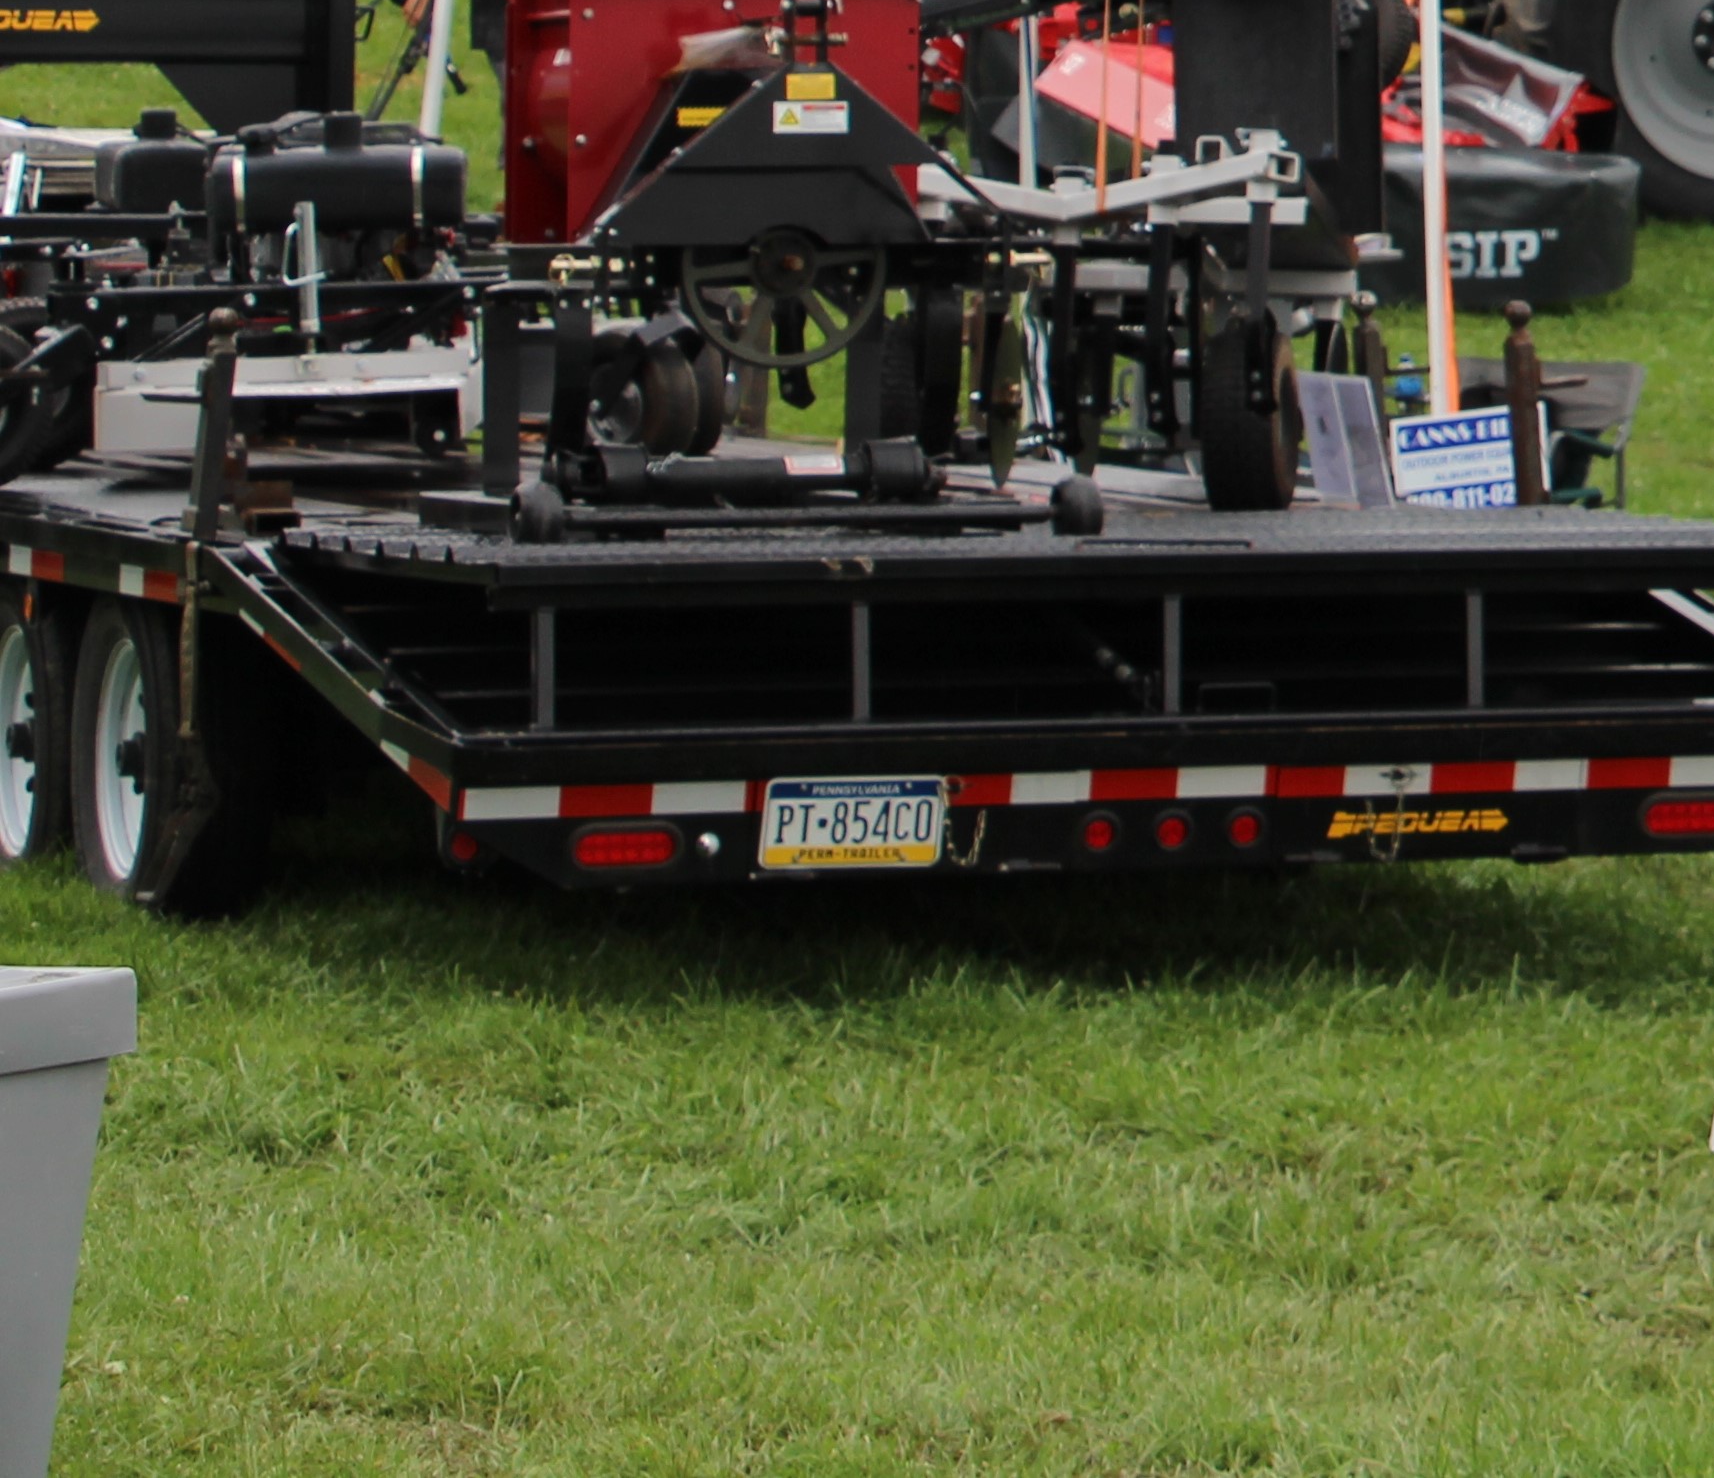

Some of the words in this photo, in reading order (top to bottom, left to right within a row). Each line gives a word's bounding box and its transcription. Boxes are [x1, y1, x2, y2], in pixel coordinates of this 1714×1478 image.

[1447, 230, 1540, 278] SIP
[811, 784, 900, 796] PENNSYLVANIA
[799, 849, 900, 860] PERM-TRAILER
